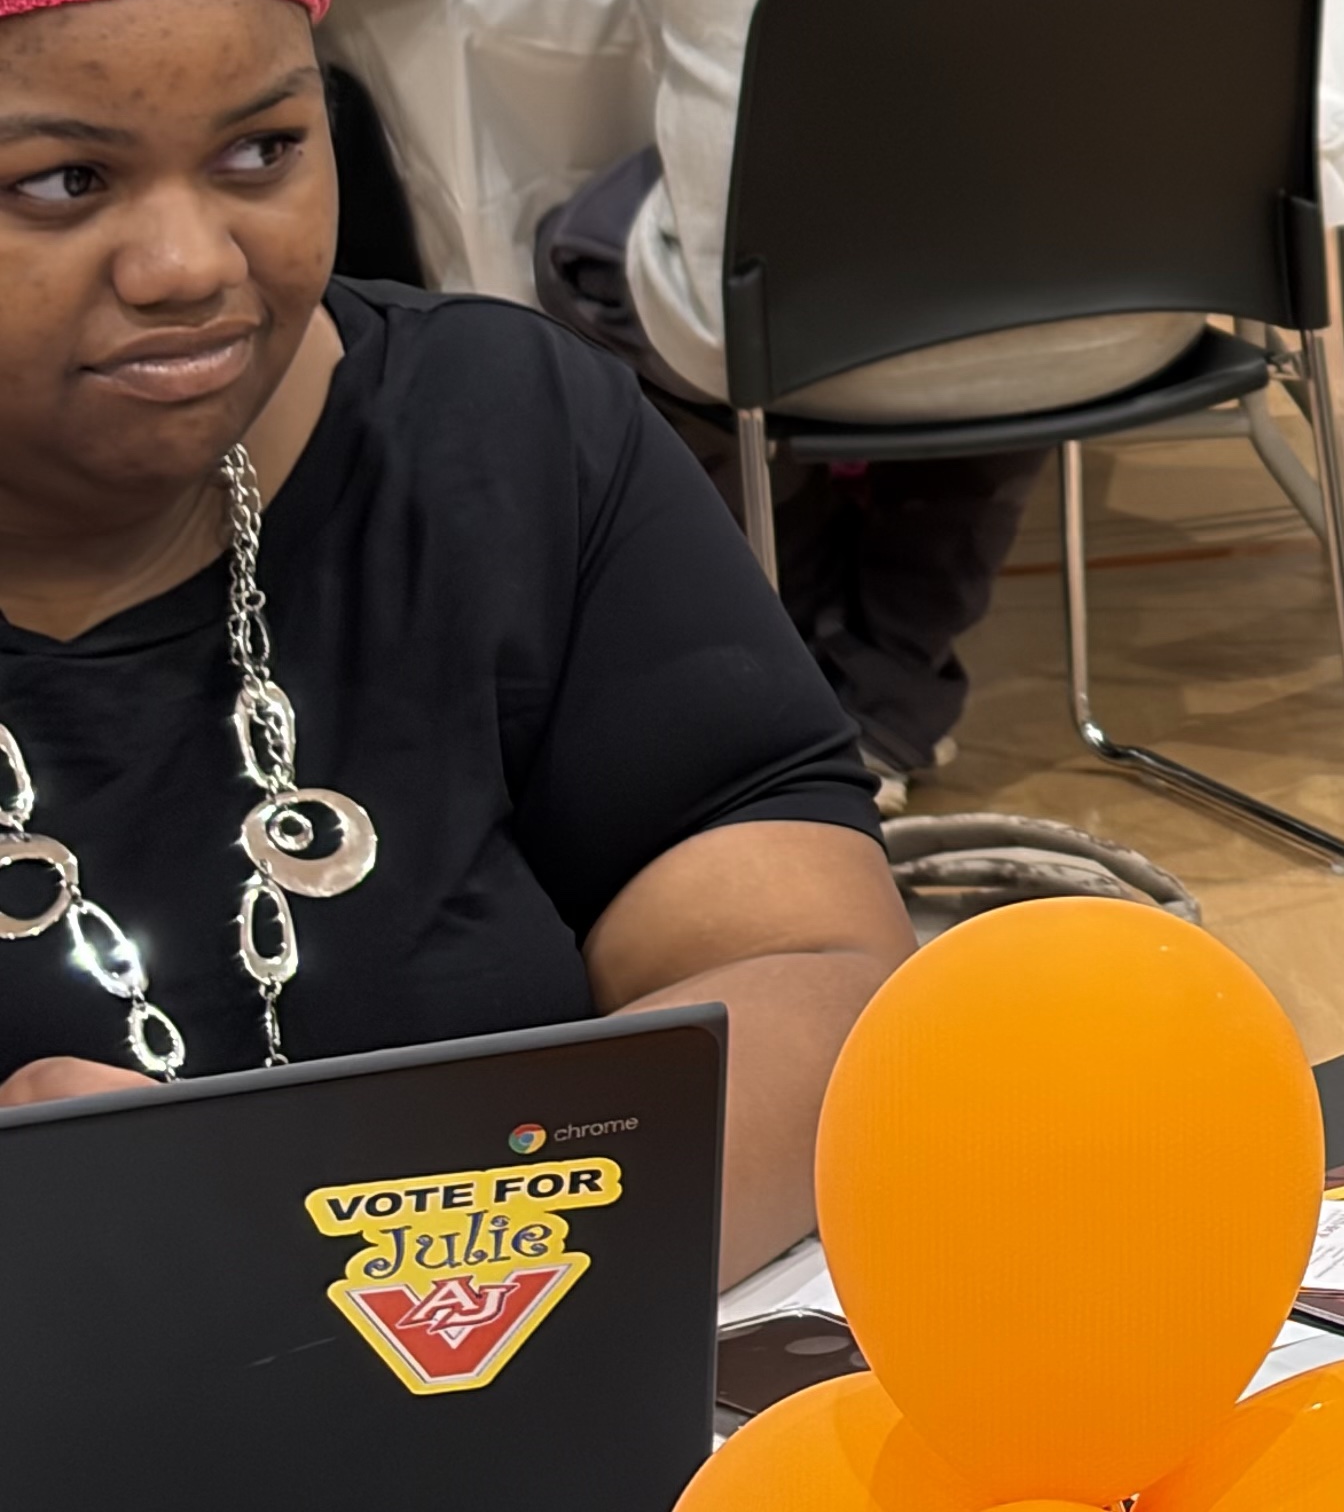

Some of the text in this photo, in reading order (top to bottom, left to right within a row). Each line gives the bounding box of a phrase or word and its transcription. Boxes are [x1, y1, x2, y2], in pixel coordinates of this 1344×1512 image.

[553, 1115, 639, 1143] chrome
[326, 1168, 603, 1221] VOTE FOR
[363, 1210, 553, 1279] Julie
